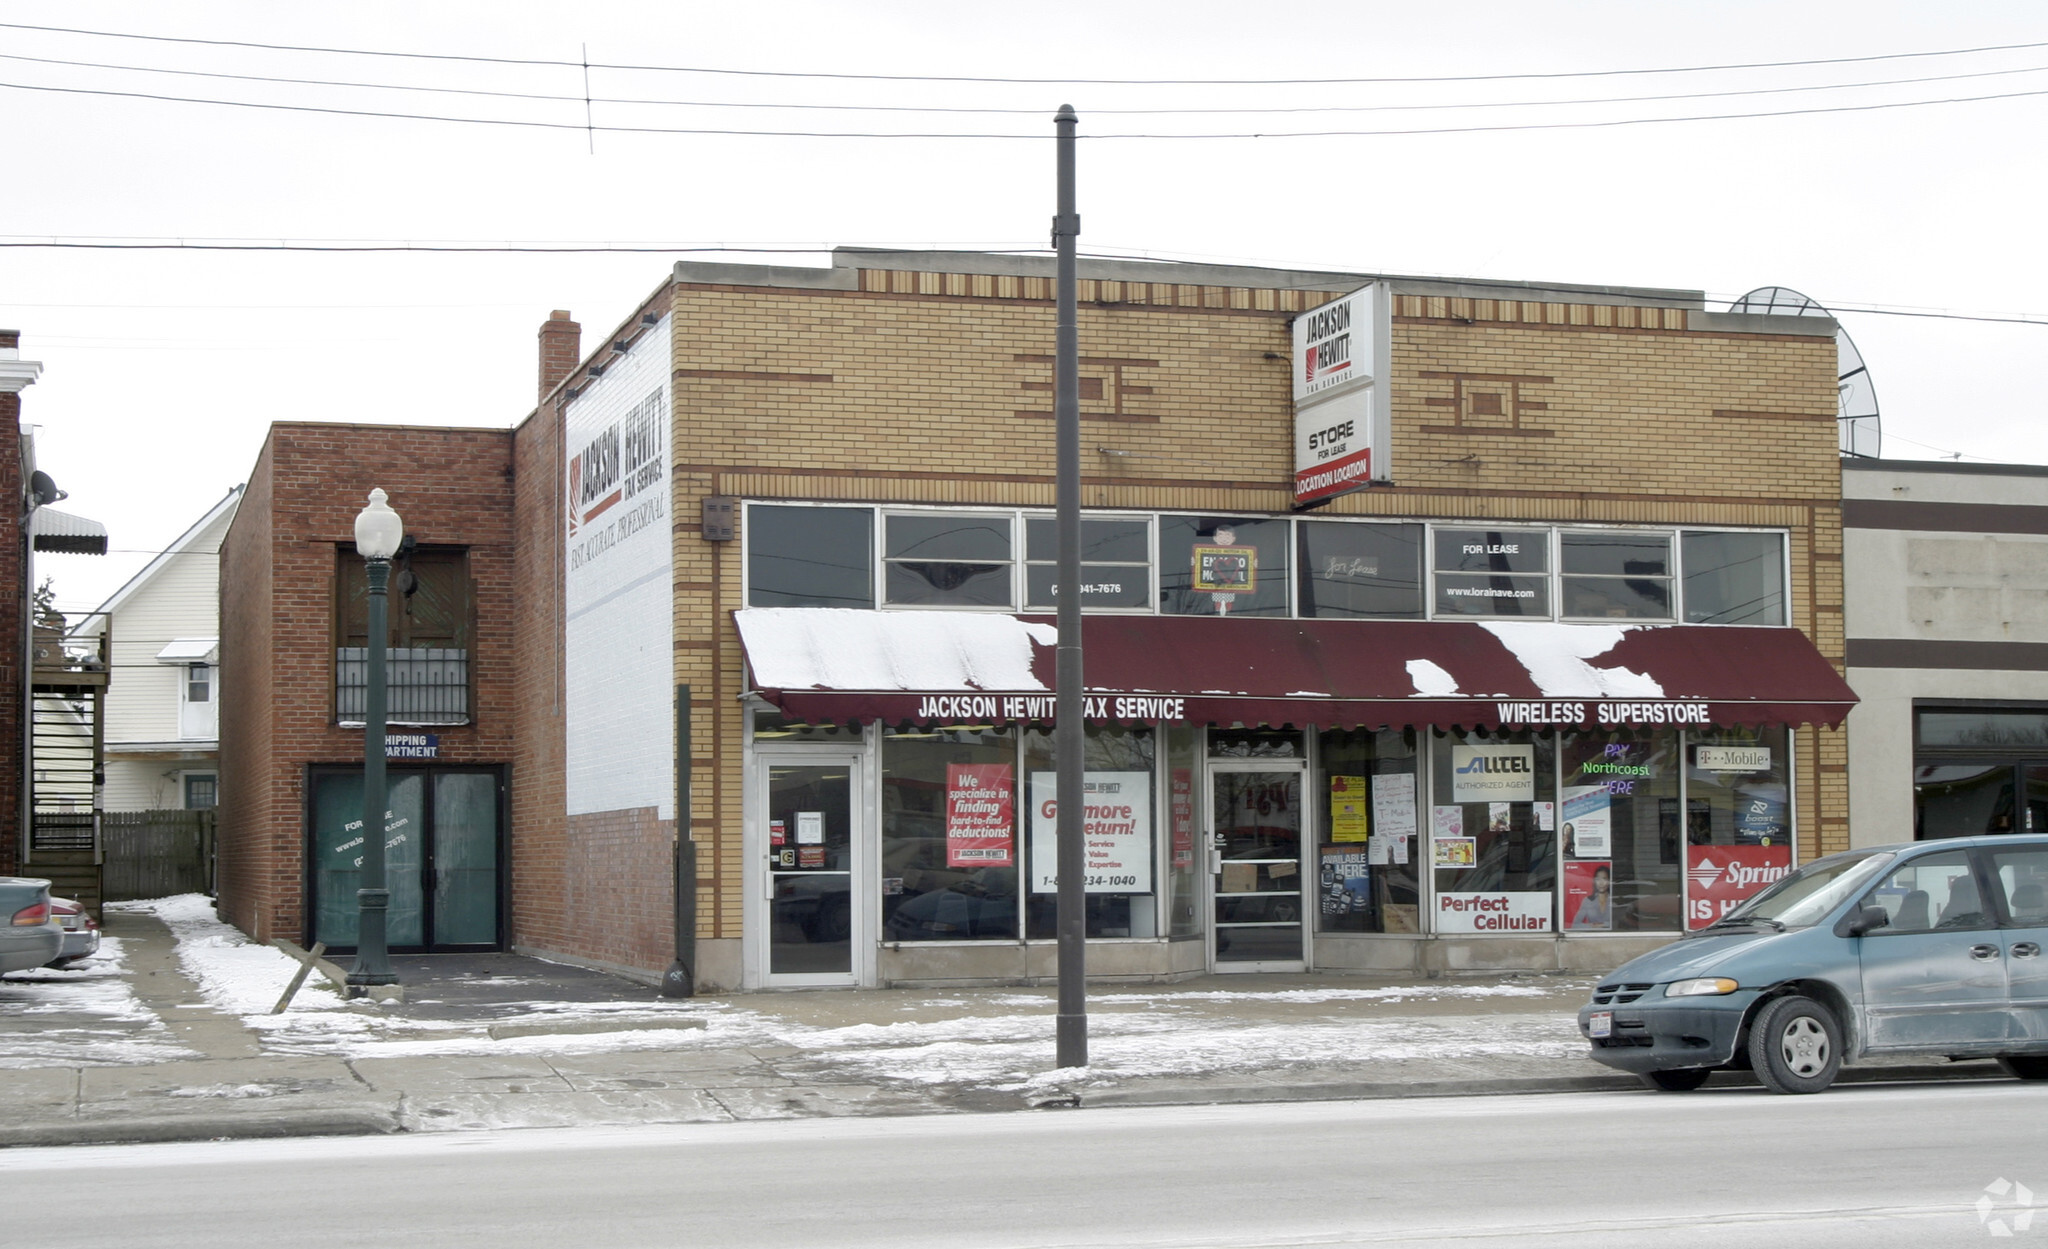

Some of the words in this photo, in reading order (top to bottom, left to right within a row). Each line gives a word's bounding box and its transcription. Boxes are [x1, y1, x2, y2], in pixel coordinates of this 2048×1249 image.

[1306, 300, 1351, 345] JACKSON
[1318, 332, 1350, 370] HEWITT
[1306, 383, 1319, 394] TAX
[1322, 370, 1353, 388] SERVICE
[1309, 420, 1354, 450] STORE
[581, 420, 620, 507] JACKSON
[625, 385, 663, 475] HEWITT
[1318, 449, 1330, 460] FOR
[1330, 443, 1347, 456] LEASE
[625, 476, 636, 501] TAX
[637, 455, 662, 493] SERVICE
[1296, 471, 1333, 495] LOCATION
[1333, 458, 1367, 483] LOCATION
[617, 491, 665, 543] PROFESSIONAL
[1463, 545, 1484, 554] FOR
[1487, 545, 1519, 555] LEASE
[1446, 587, 1535, 598] www.lorainave.com
[918, 696, 997, 718] JACKSON
[1003, 697, 1056, 718] HEWIT
[1115, 698, 1184, 719] SERVICE
[1497, 702, 1585, 724] WIRELESS
[1597, 703, 1710, 724] SUPERSTORE
[385, 735, 427, 746] HIPPING
[1456, 756, 1531, 774] ALLTEL
[959, 775, 978, 787] We
[1455, 782, 1504, 790] AUTHORIZED
[949, 789, 996, 800] specialize
[999, 788, 1008, 798] in
[955, 800, 1000, 815] finding
[344, 820, 363, 831] FOR
[951, 816, 1002, 824] hard-to-find
[1744, 814, 1774, 823] boost
[949, 826, 1010, 838] deductions!
[1083, 819, 1136, 835] eturn!
[1088, 861, 1122, 869] Expertise
[1322, 854, 1366, 864] AVAILABLE
[1336, 864, 1367, 878] HERE
[1441, 895, 1509, 912] Perfect
[1690, 899, 1713, 920] IS
[1473, 914, 1547, 930] Cellular
